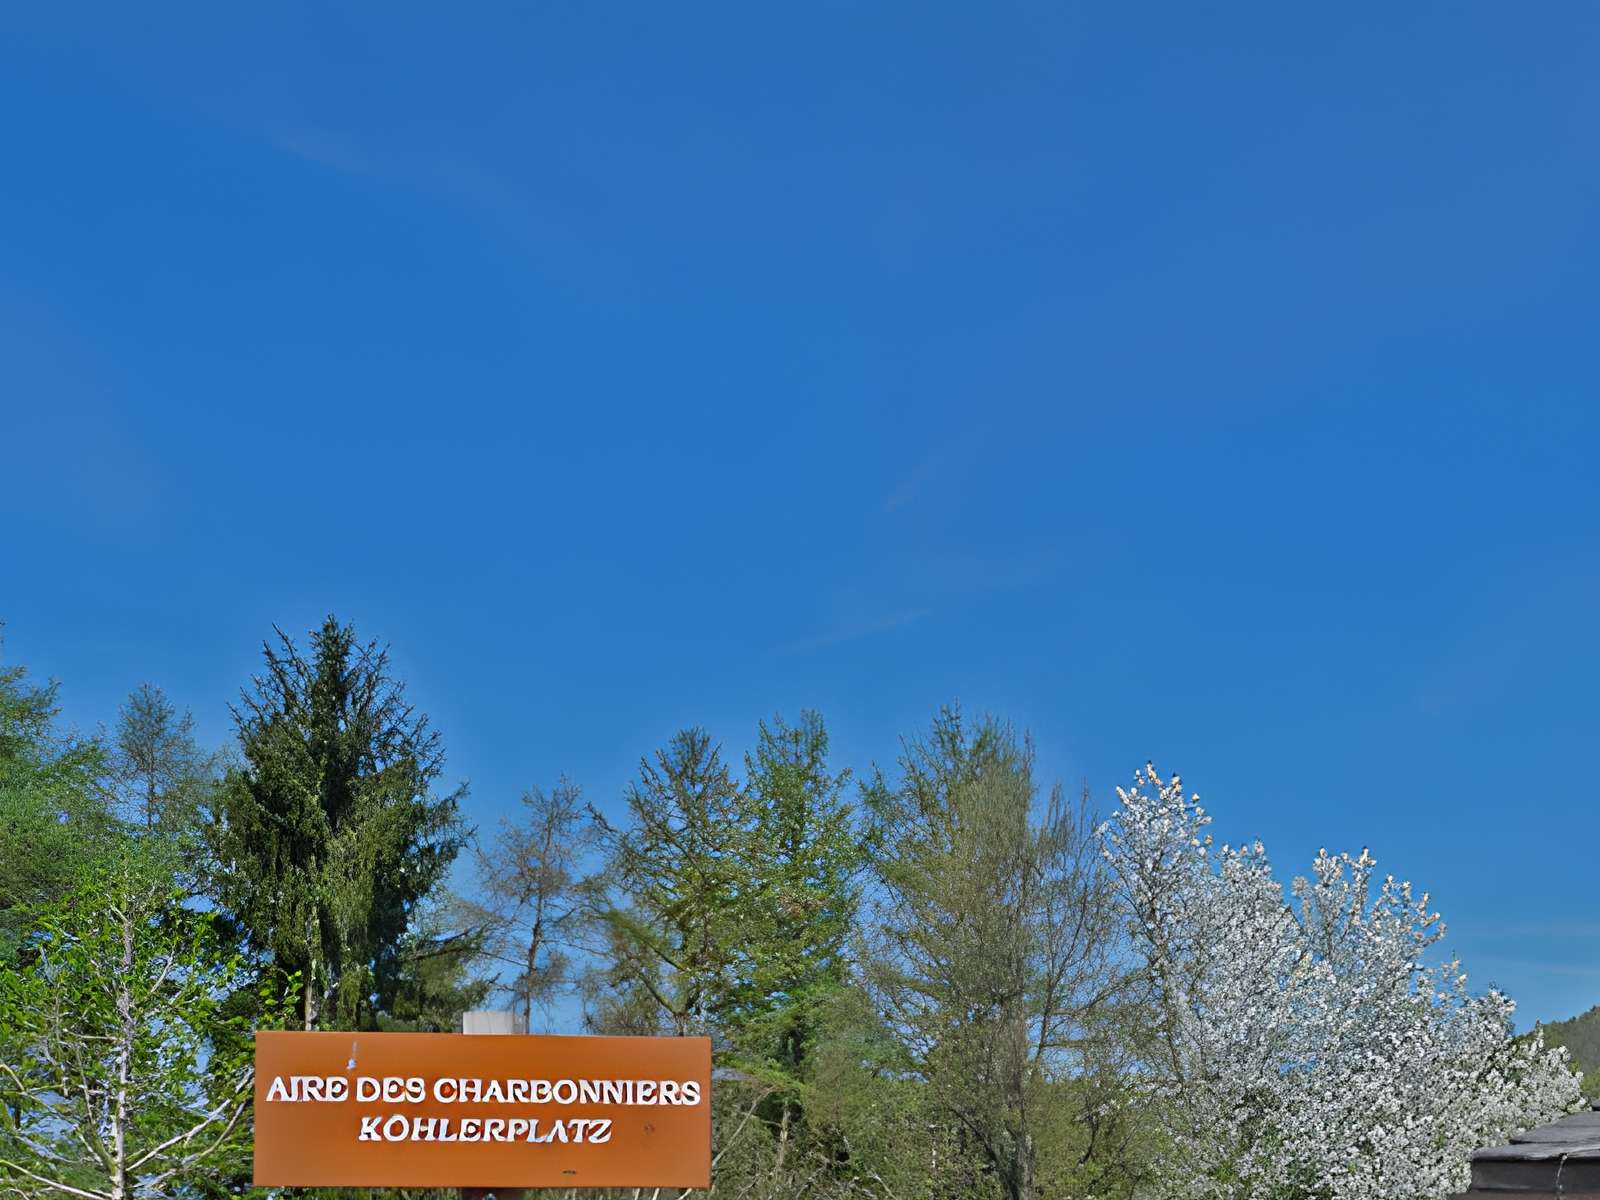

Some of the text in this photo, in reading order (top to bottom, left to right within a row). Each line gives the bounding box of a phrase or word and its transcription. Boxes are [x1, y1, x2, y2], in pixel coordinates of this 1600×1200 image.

[265, 1075, 702, 1106] AIRE DES CHARBONNIERS
